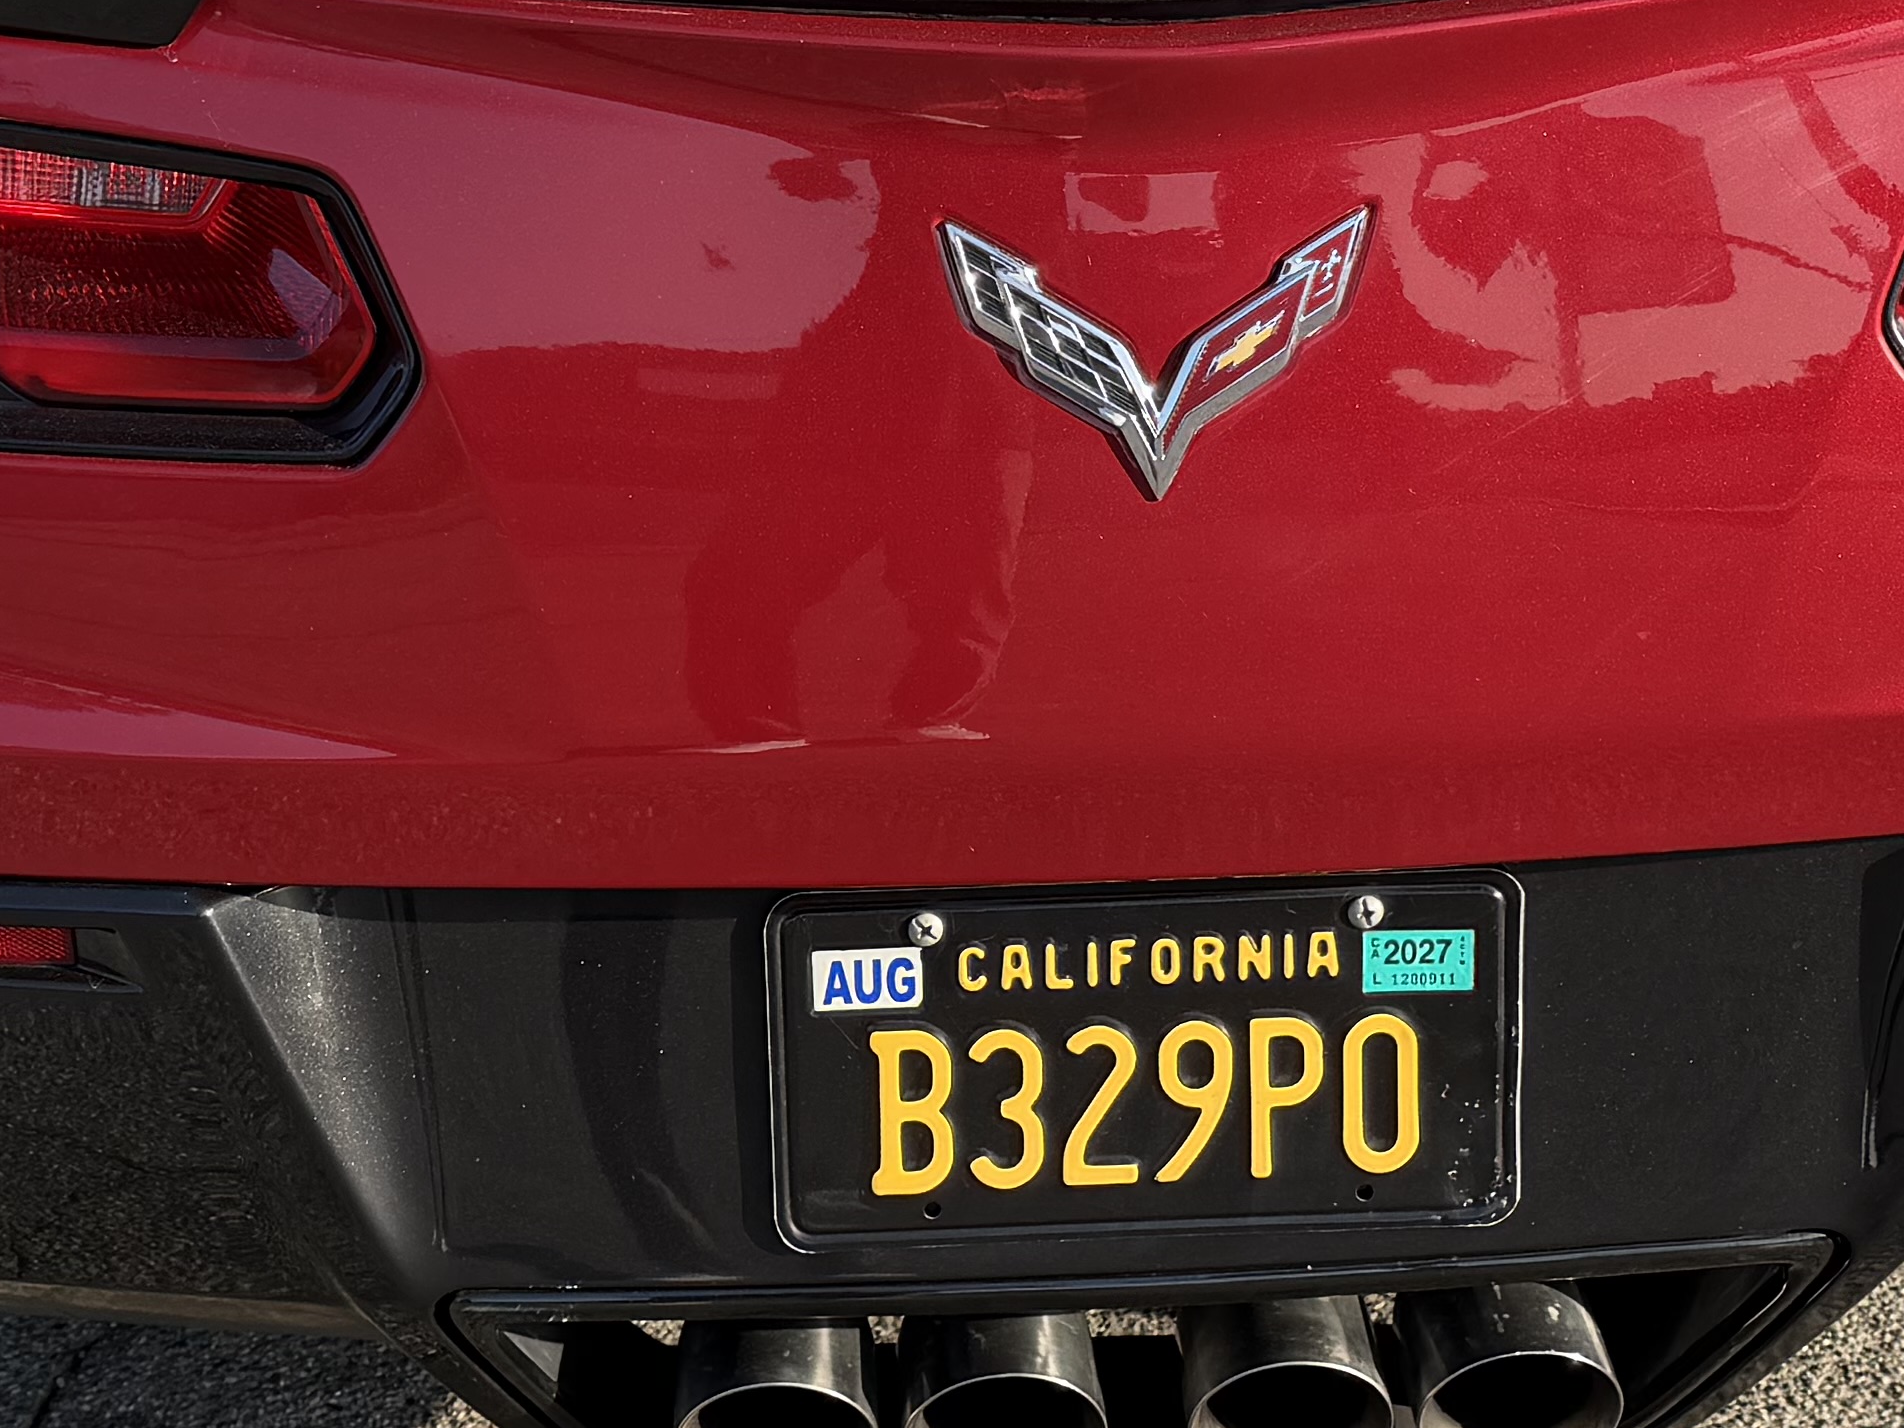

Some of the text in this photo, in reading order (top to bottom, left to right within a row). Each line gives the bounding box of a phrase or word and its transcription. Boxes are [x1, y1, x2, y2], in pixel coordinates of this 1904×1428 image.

[958, 931, 1339, 992] CALIFORNIA
[1370, 937, 1381, 960] CA
[1383, 938, 1453, 965] 2027
[823, 957, 916, 1005] AUG
[1372, 973, 1382, 985] L
